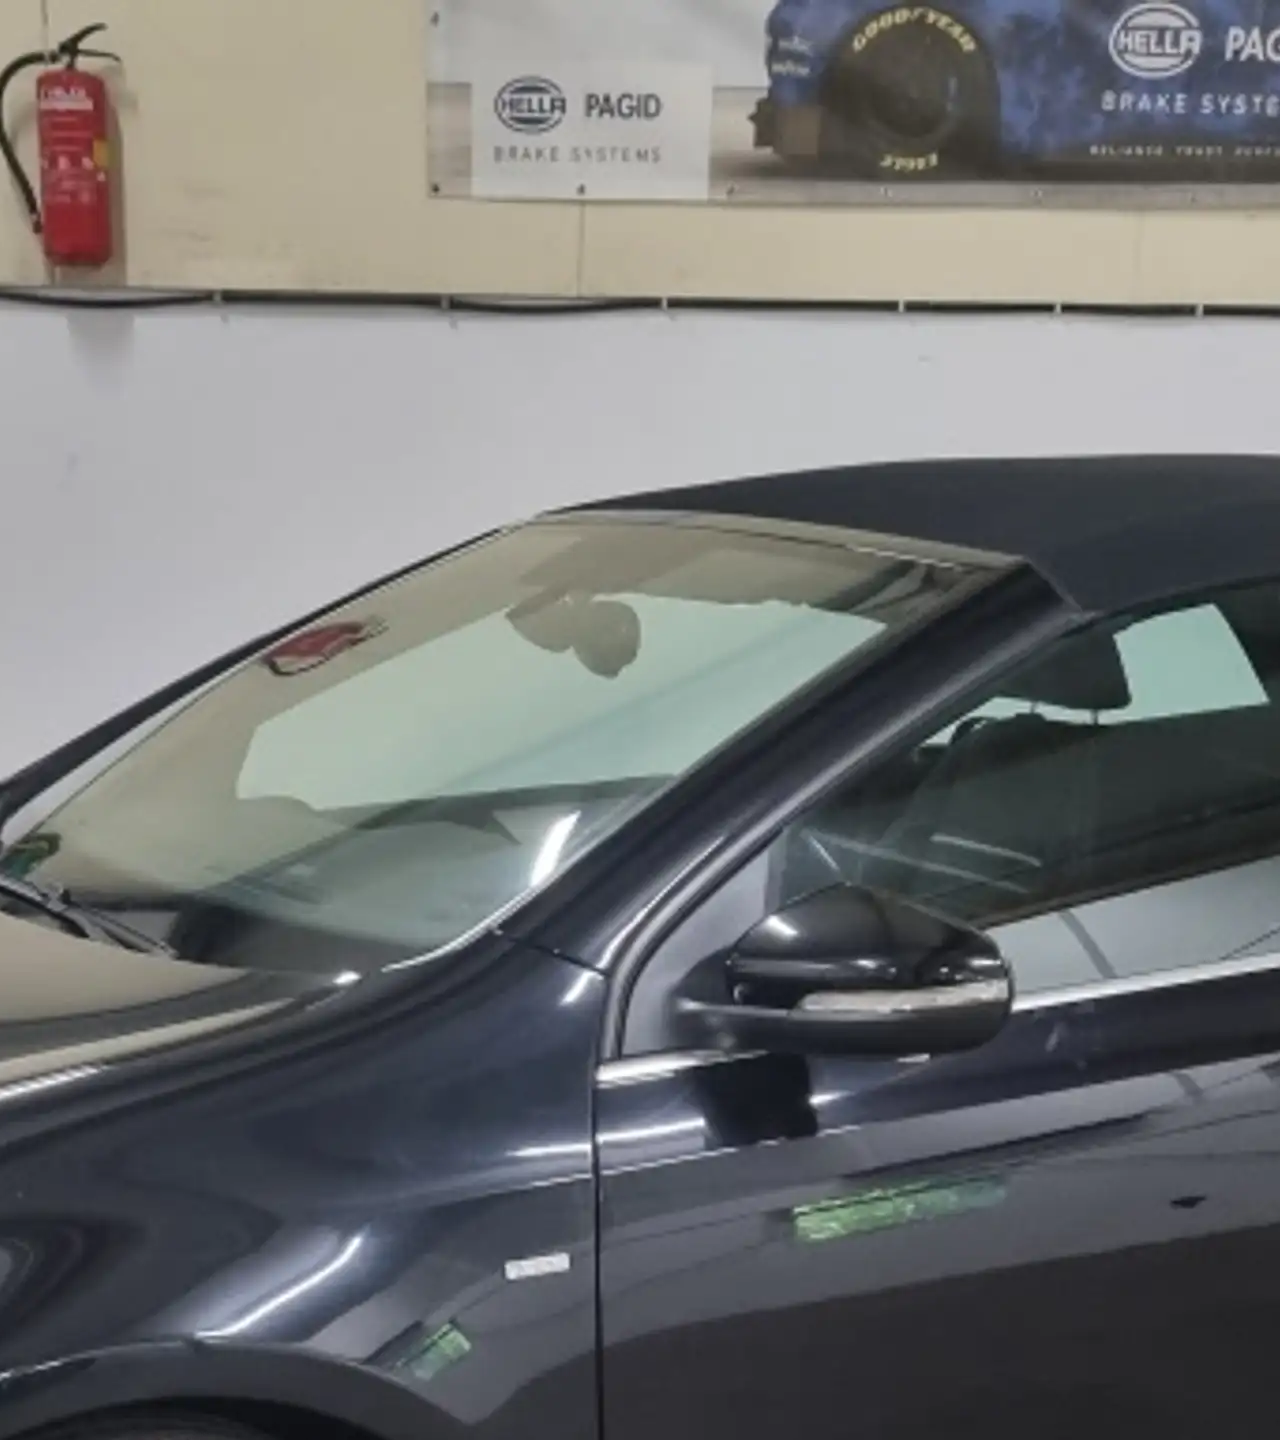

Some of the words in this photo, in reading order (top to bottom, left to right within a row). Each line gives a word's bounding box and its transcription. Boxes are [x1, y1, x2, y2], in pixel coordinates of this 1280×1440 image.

[1120, 29, 1203, 55] HELLA
[585, 93, 662, 119] PAGID
[1101, 89, 1188, 115] BRAKE
[494, 145, 559, 163] BRAKE
[570, 146, 662, 163] SYSTEMS
